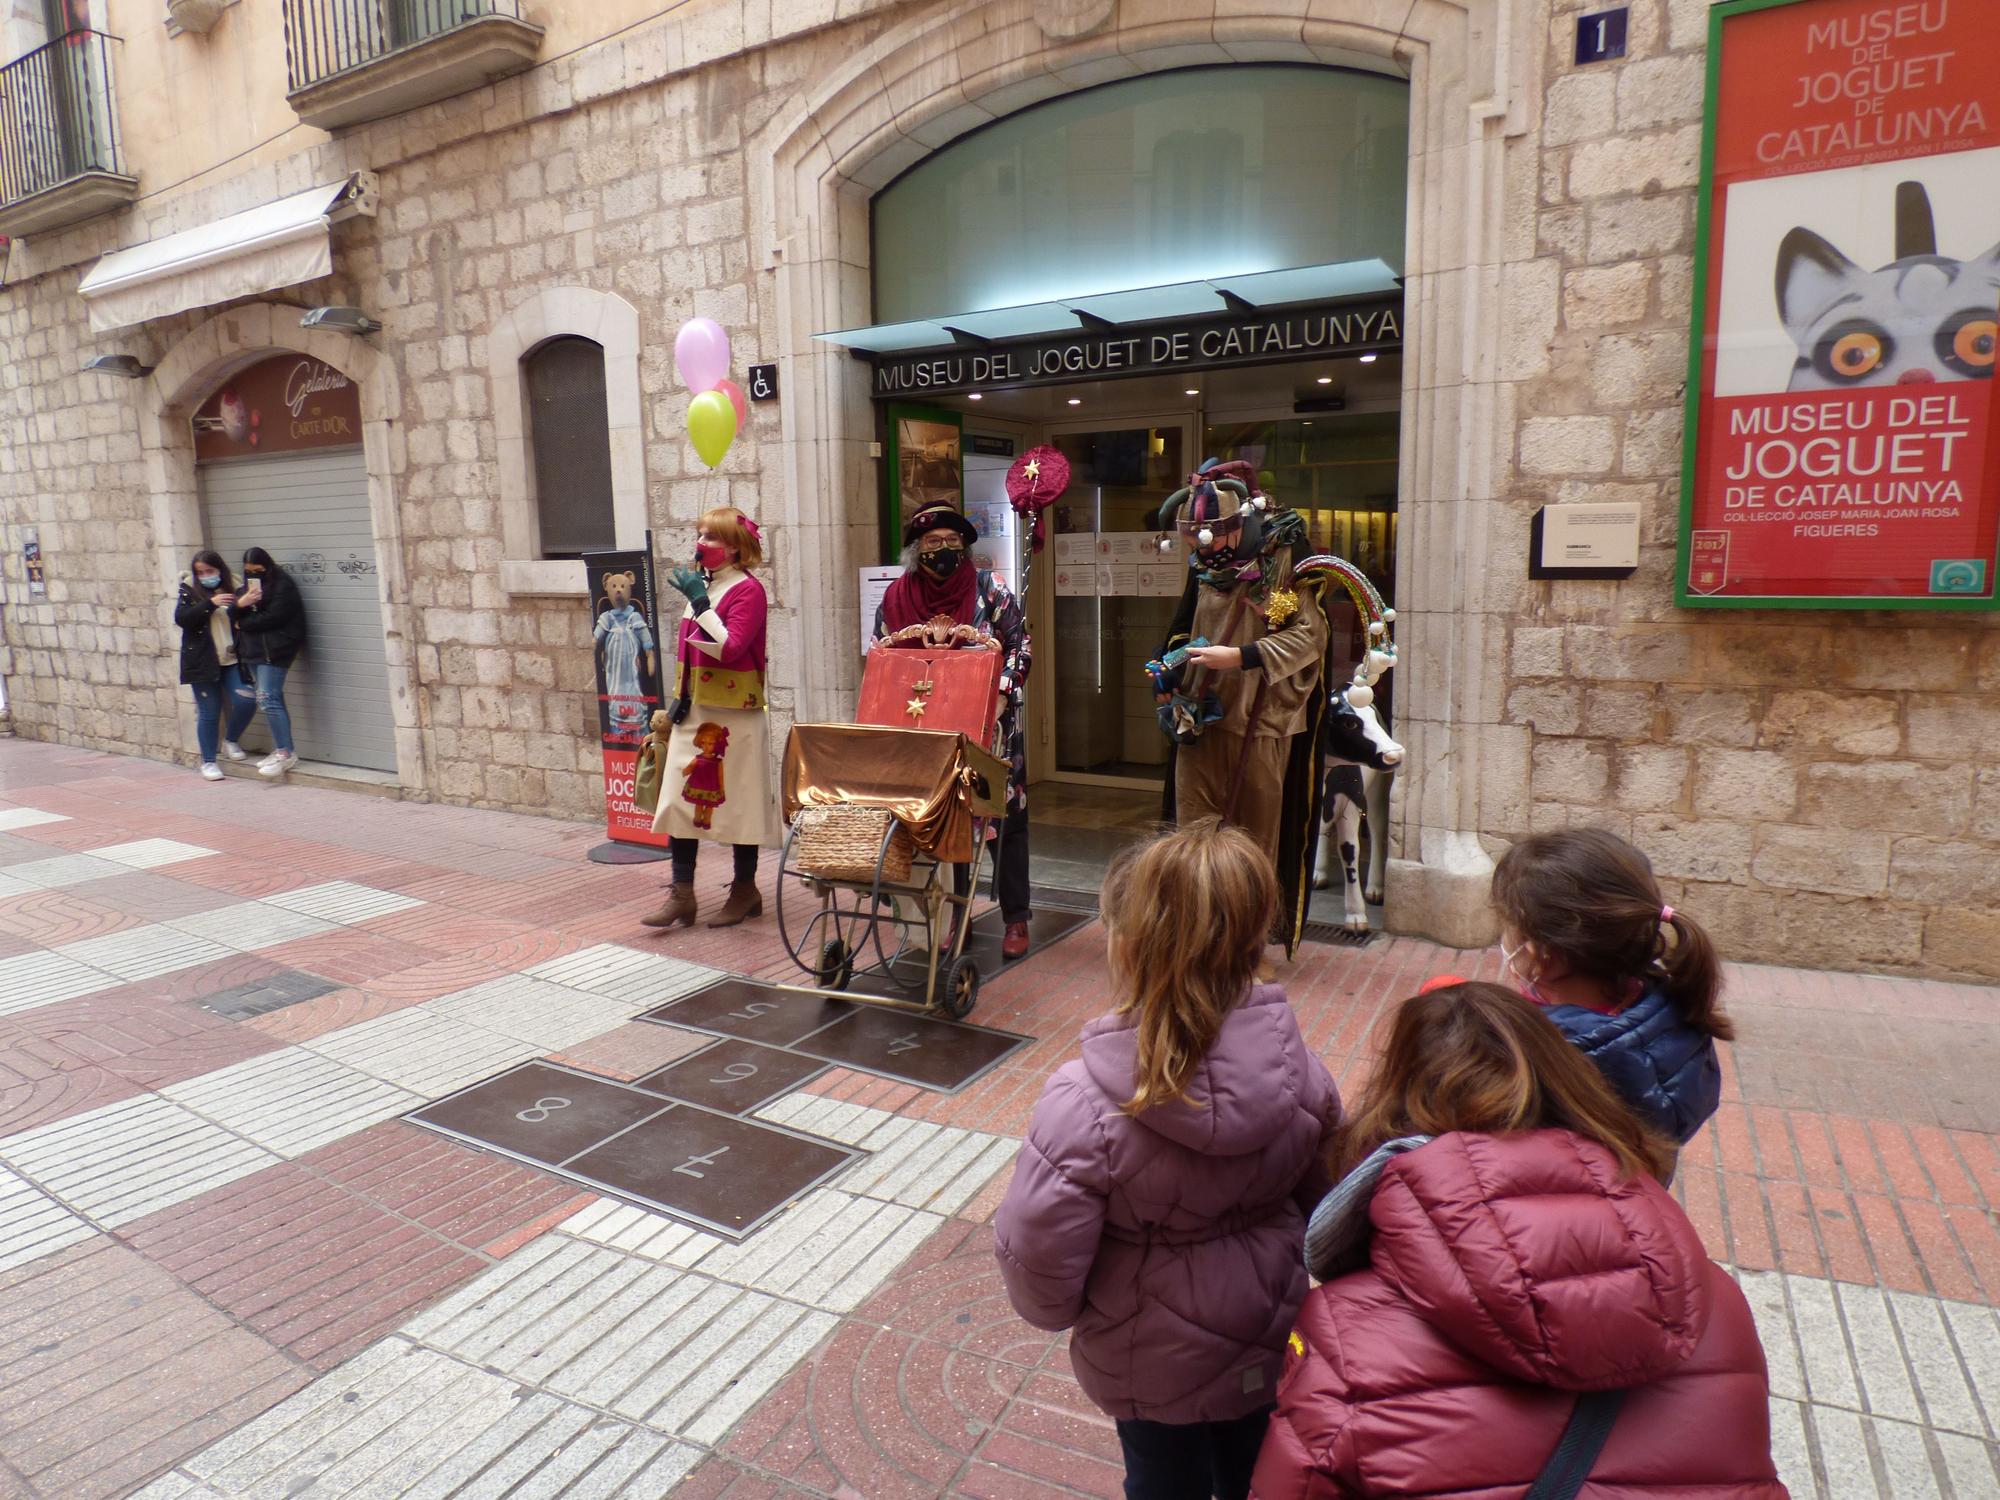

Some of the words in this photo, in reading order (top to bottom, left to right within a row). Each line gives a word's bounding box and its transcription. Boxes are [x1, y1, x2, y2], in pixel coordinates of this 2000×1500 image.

[1596, 19, 1606, 53] 1
[1807, 0, 1948, 54] MUSEU
[1852, 44, 1895, 66] DEL
[1793, 52, 1955, 108] JOGUET
[1855, 96, 1885, 117] DE
[1756, 101, 1987, 162] CATALUNYA
[1864, 148, 1900, 163] MARIA
[1903, 144, 1932, 157] JOAN
[1943, 138, 1975, 151] ROSA
[879, 359, 962, 391] MUSEU
[973, 353, 1021, 381] DEL
[1029, 339, 1140, 375] JOGUET
[1151, 332, 1189, 362] DE
[1200, 310, 1400, 357] CATALUNYA
[285, 361, 348, 417] Gelateria
[1730, 400, 1873, 436] MUSEU
[1888, 395, 1970, 427] DEL
[1726, 431, 1968, 480] JOGUET
[1725, 486, 1765, 508] DE
[1774, 480, 1963, 507] CATALUNYA
[1797, 509, 1838, 521] JOSEP
[1840, 509, 1880, 520] MARIA
[1883, 507, 1919, 519] JOAN
[1921, 506, 1960, 518] ROSA
[1793, 523, 1879, 537] FIGUERES
[611, 761, 635, 775] MUS
[606, 778, 634, 797] JOG
[617, 816, 653, 831] FIGUERE
[516, 1096, 572, 1122] 8
